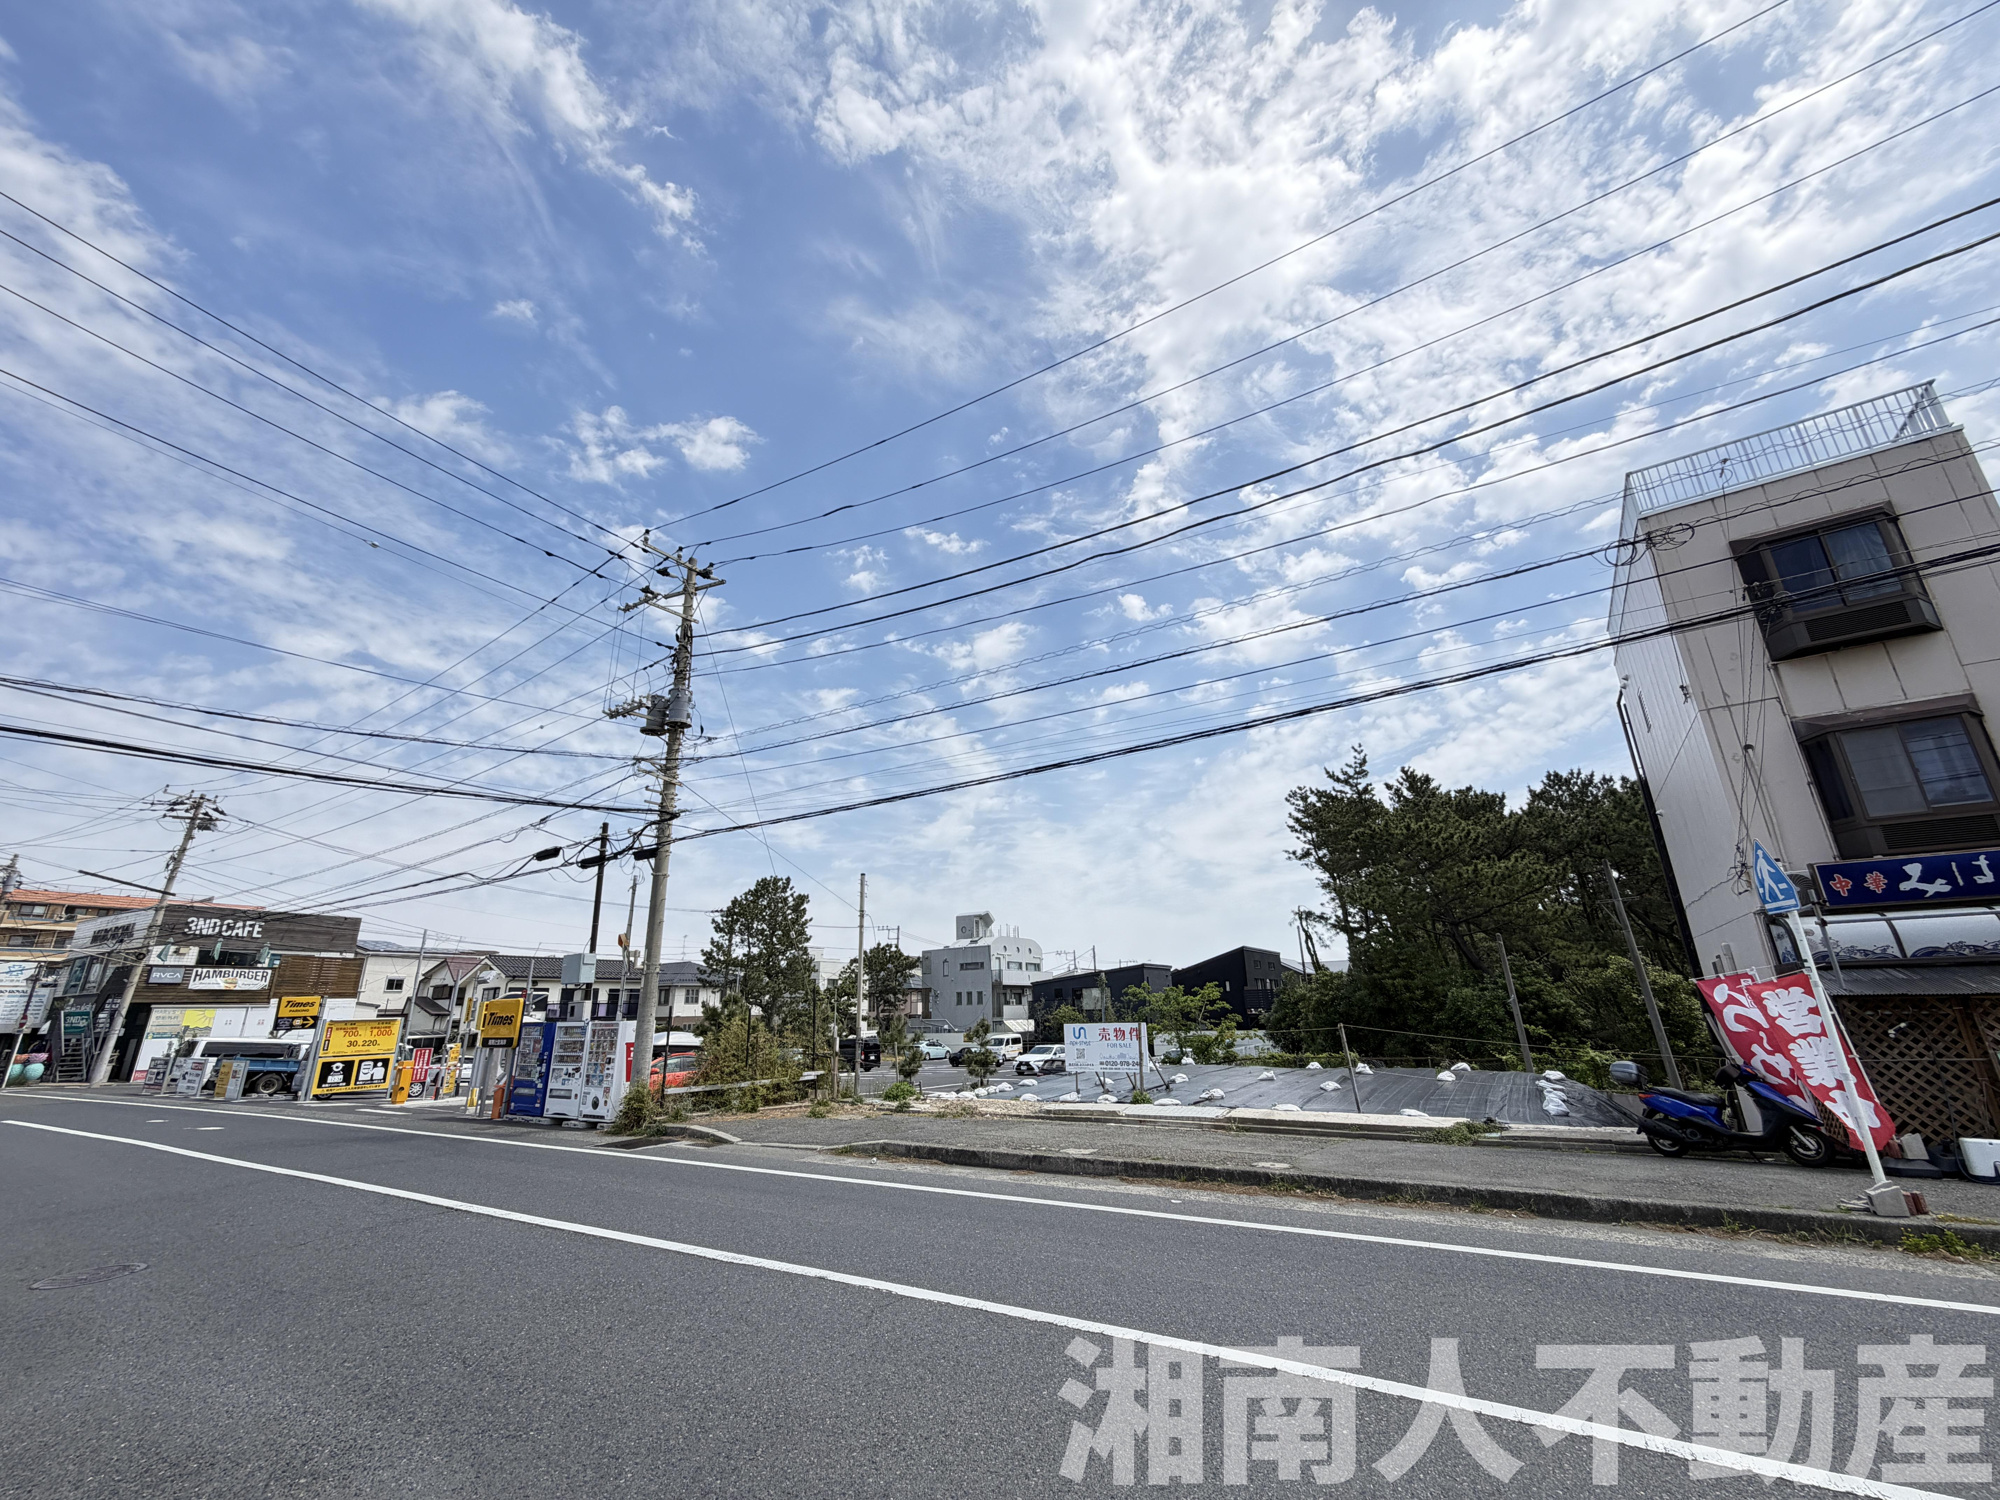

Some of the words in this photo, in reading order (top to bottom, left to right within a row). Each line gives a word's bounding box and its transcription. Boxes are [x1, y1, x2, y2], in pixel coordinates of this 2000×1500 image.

[1829, 870, 1888, 897] 中華
[184, 917, 219, 936] 3ND
[221, 919, 265, 938] CAFE
[193, 969, 269, 983] HAMBURGER
[284, 1000, 316, 1008] Times
[487, 1011, 515, 1026] Times
[1098, 1027, 1140, 1041] 売物件
